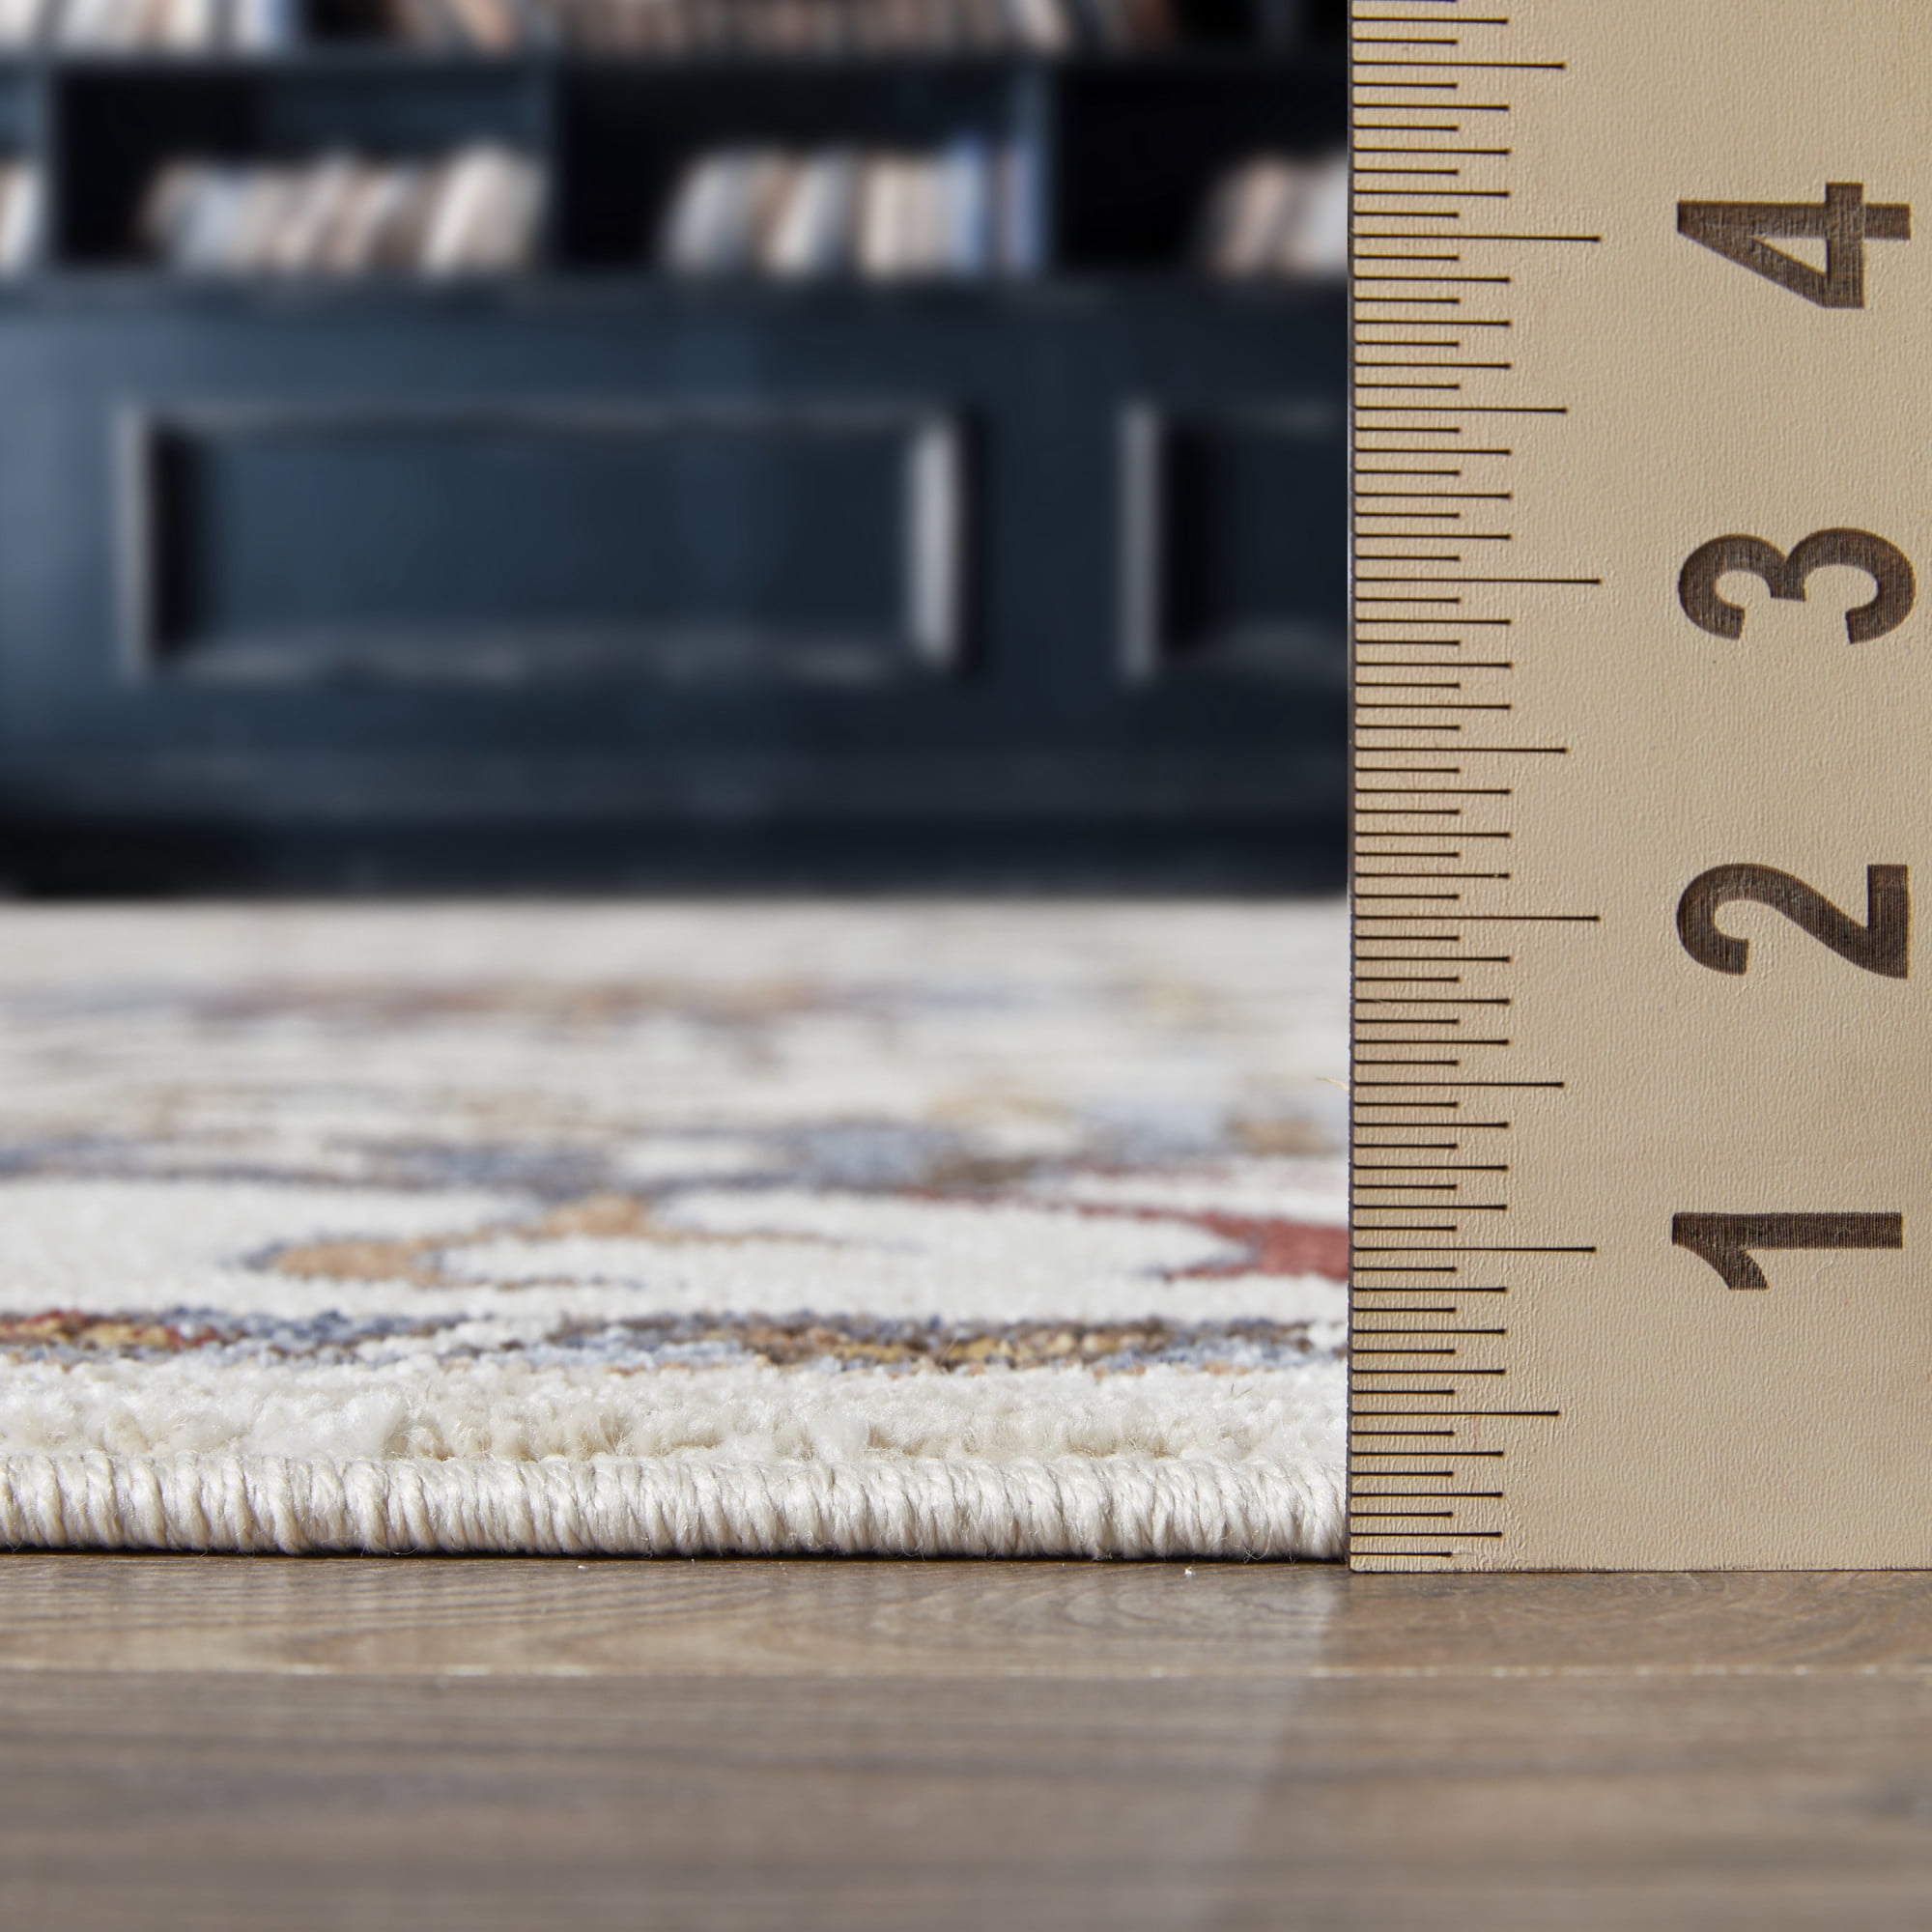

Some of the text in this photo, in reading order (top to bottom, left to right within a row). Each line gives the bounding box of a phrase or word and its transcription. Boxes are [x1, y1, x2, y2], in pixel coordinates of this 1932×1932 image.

[1677, 182, 1912, 310] 4
[1677, 526, 1917, 645] 3
[1676, 862, 1910, 980] 2
[1671, 1210, 1904, 1292] 1
